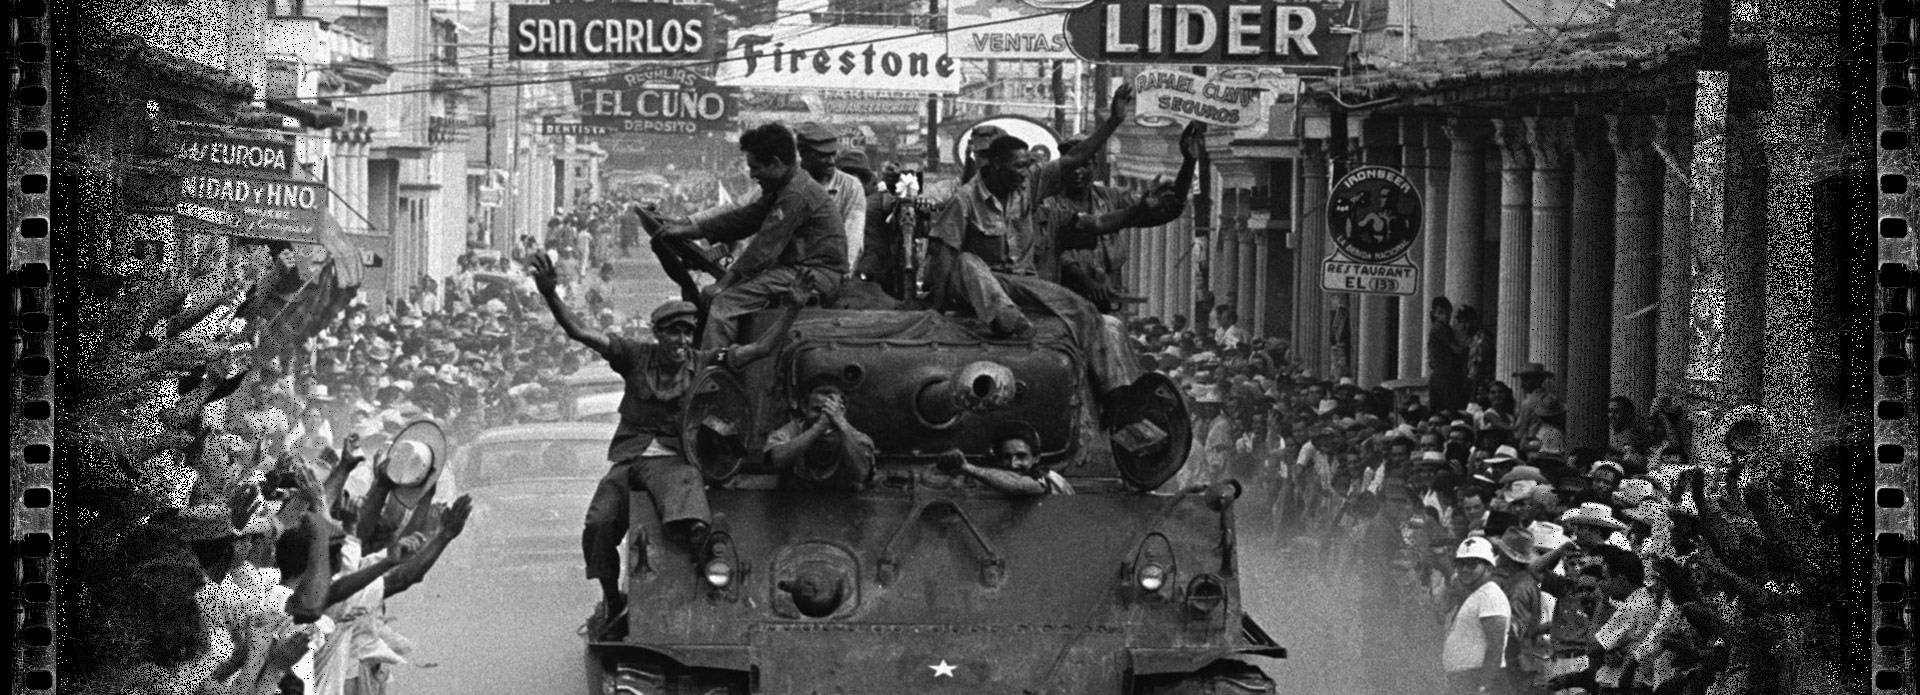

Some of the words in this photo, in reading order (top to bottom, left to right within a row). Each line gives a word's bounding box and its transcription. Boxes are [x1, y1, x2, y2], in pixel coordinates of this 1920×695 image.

[518, 18, 577, 54] SAN
[584, 18, 703, 54] CARLOS
[972, 32, 1067, 52] VENTAS
[1105, 3, 1319, 57] LIDER
[735, 33, 955, 78] Firestone
[1136, 72, 1196, 94] RAFAEL
[594, 88, 632, 117] EL
[636, 87, 725, 120] CUÑO
[1157, 95, 1241, 124] SEGUROS
[546, 125, 606, 135] DENTISTA
[624, 119, 697, 133] DEPOSITO
[210, 142, 286, 170] EUROPA
[1342, 168, 1411, 193] IRONBEER
[1326, 263, 1411, 278] RESTAURANT
[1345, 276, 1366, 290] EL
